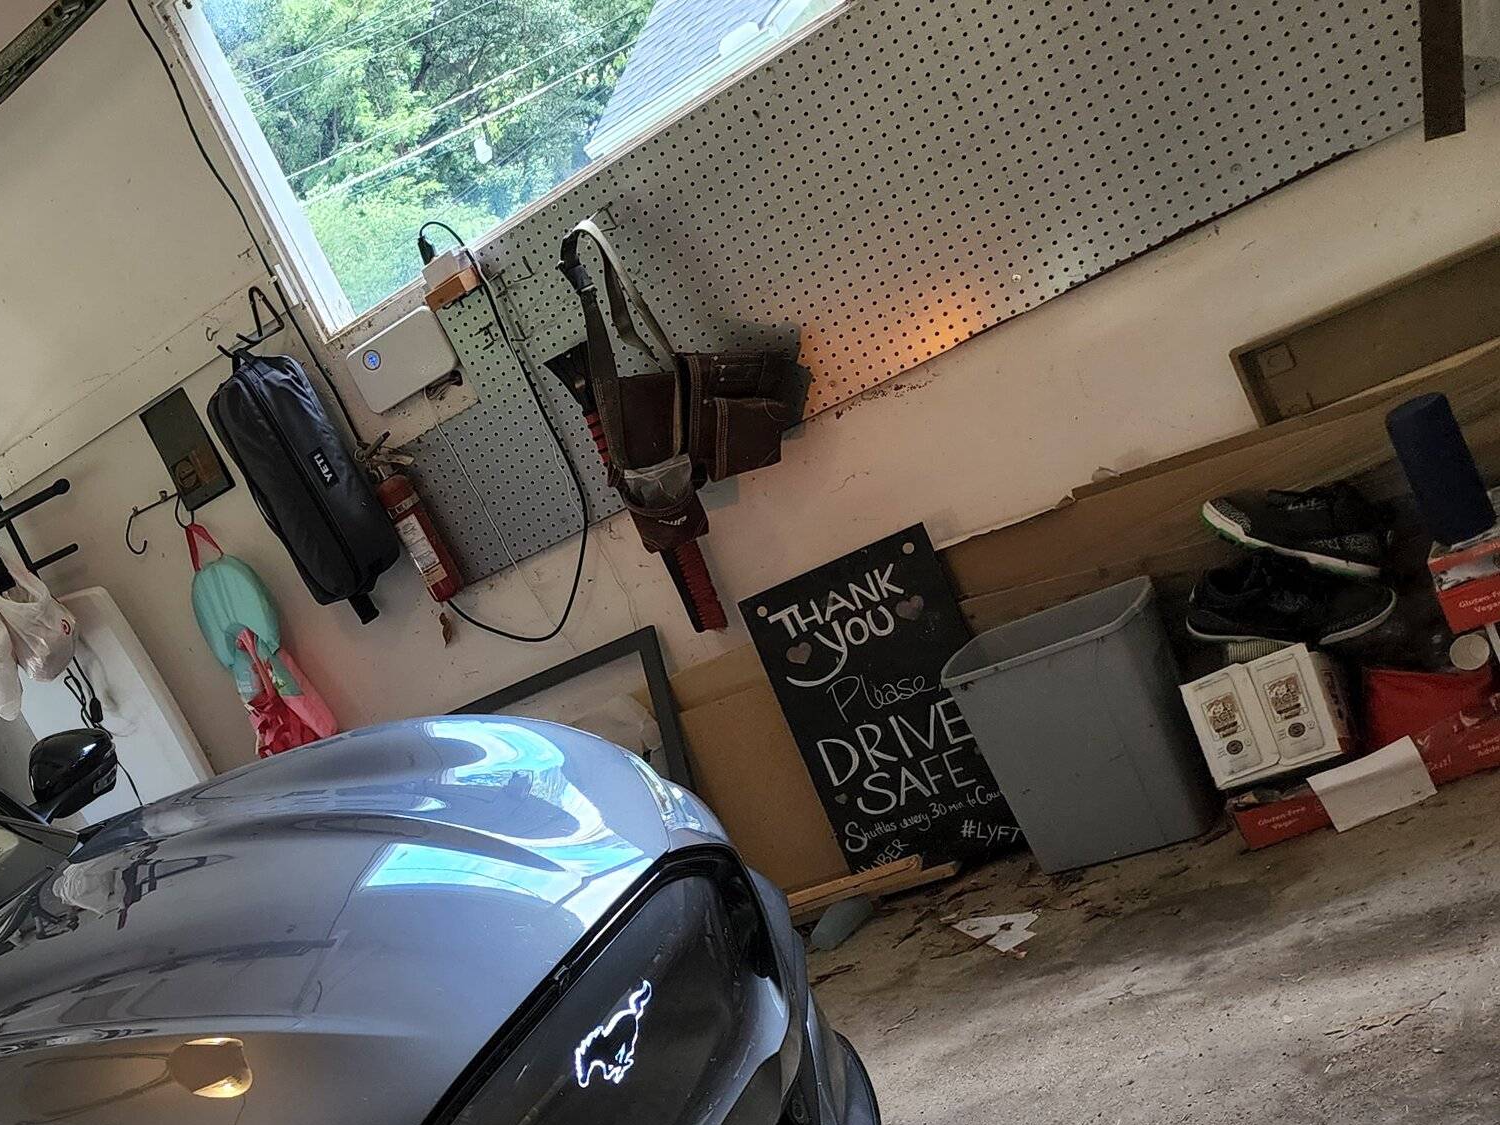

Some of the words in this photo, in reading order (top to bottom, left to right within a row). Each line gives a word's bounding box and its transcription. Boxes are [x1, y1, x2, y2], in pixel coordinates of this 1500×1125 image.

[313, 453, 333, 483] YETI
[767, 563, 905, 640] THANK
[786, 605, 895, 688] YOU
[816, 697, 975, 787] DRIVE
[857, 747, 977, 815] SAFE
[929, 802, 947, 819] 30
[960, 819, 1023, 847] #LYFT
